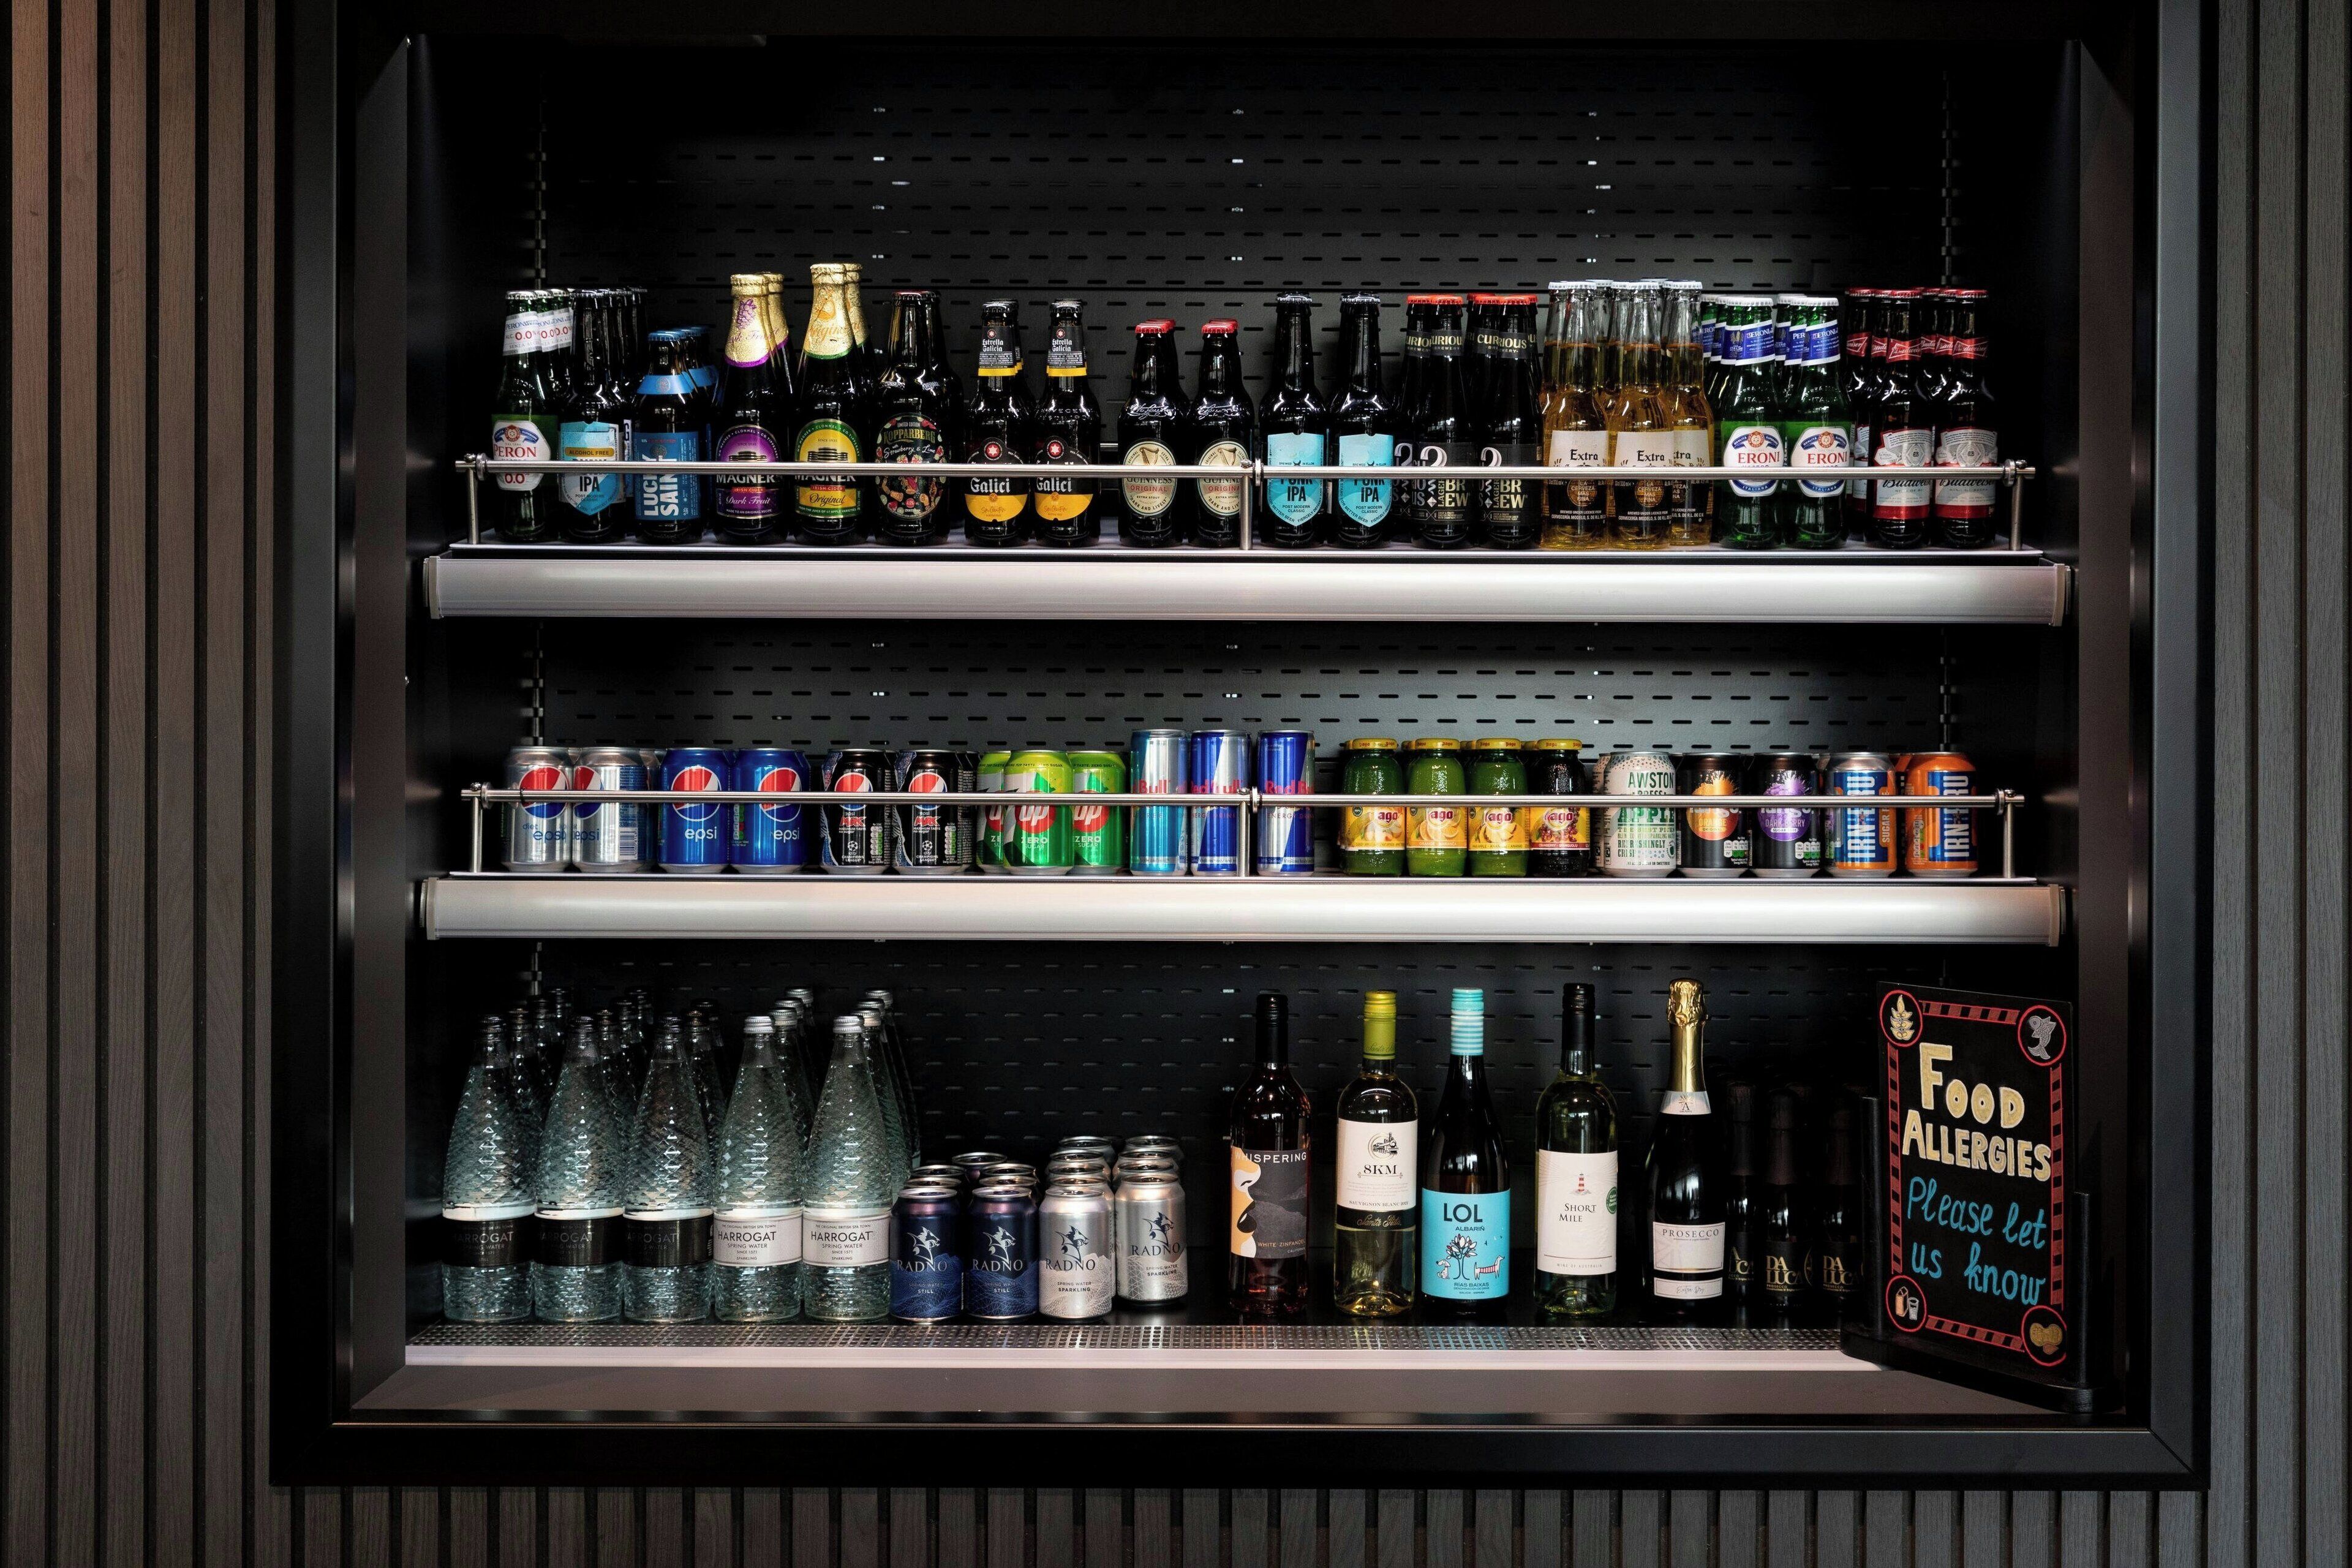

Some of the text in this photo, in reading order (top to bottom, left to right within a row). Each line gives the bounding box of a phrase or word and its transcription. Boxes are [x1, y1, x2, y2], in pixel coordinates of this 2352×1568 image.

[883, 429, 936, 444] KOPPARBERG
[884, 447, 916, 459] Strawberry
[922, 444, 936, 453] Lime
[1570, 449, 1598, 461] Extra
[1637, 450, 1665, 461] Extra
[1738, 451, 1780, 464] ERONI
[1807, 451, 1847, 464] ERONI
[579, 476, 600, 492] IPA
[1446, 479, 1466, 491] BR
[1501, 479, 1521, 492] BR
[726, 496, 771, 505] Dark Fruit
[809, 492, 845, 507] Original
[1287, 486, 1306, 502] IPA
[1361, 487, 1379, 502] IPA
[1446, 492, 1468, 507] EW
[1501, 494, 1525, 508] EW
[1273, 505, 1284, 517] BETTER
[1139, 779, 1167, 793] Bull
[1265, 779, 1295, 794] Red
[1628, 772, 1675, 788] AWSTON
[1019, 805, 1050, 826] up
[1074, 805, 1102, 825] up
[1378, 812, 1398, 823] ago
[1430, 810, 1453, 822] ago
[1618, 807, 1675, 823] APPLE
[1765, 819, 1783, 827] DARK
[685, 826, 717, 842] epsi
[1944, 824, 1970, 857] IRN
[1618, 840, 1665, 848] REFRESHINGLY
[1847, 825, 1875, 858] IRN
[1618, 849, 1635, 858] CRISP
[1919, 1042, 2025, 1129] FOOD
[1902, 1109, 2052, 1182] ALLERGIES
[1235, 1151, 1307, 1163] WHISPERING
[1363, 1164, 1397, 1175] 8KM
[1444, 1203, 1482, 1223] LOL
[1564, 1203, 1597, 1213] SHORT
[1907, 1176, 2046, 1250] Please let
[1357, 1214, 1401, 1227] Santa Rita
[1559, 1213, 1583, 1222] MILE
[718, 1231, 777, 1242] HARROGAT
[811, 1231, 873, 1242] HARROGAT
[1662, 1229, 1719, 1237] PROSECCO
[1131, 1243, 1180, 1256] RADNO
[897, 1260, 948, 1272] RADNO
[973, 1259, 1023, 1272] RADNO
[1045, 1258, 1096, 1271] RADNO
[1766, 1256, 1789, 1270] DA
[1823, 1256, 1845, 1270] DA
[1766, 1270, 1803, 1285] LUCA
[1912, 1242, 2046, 1306] us know
